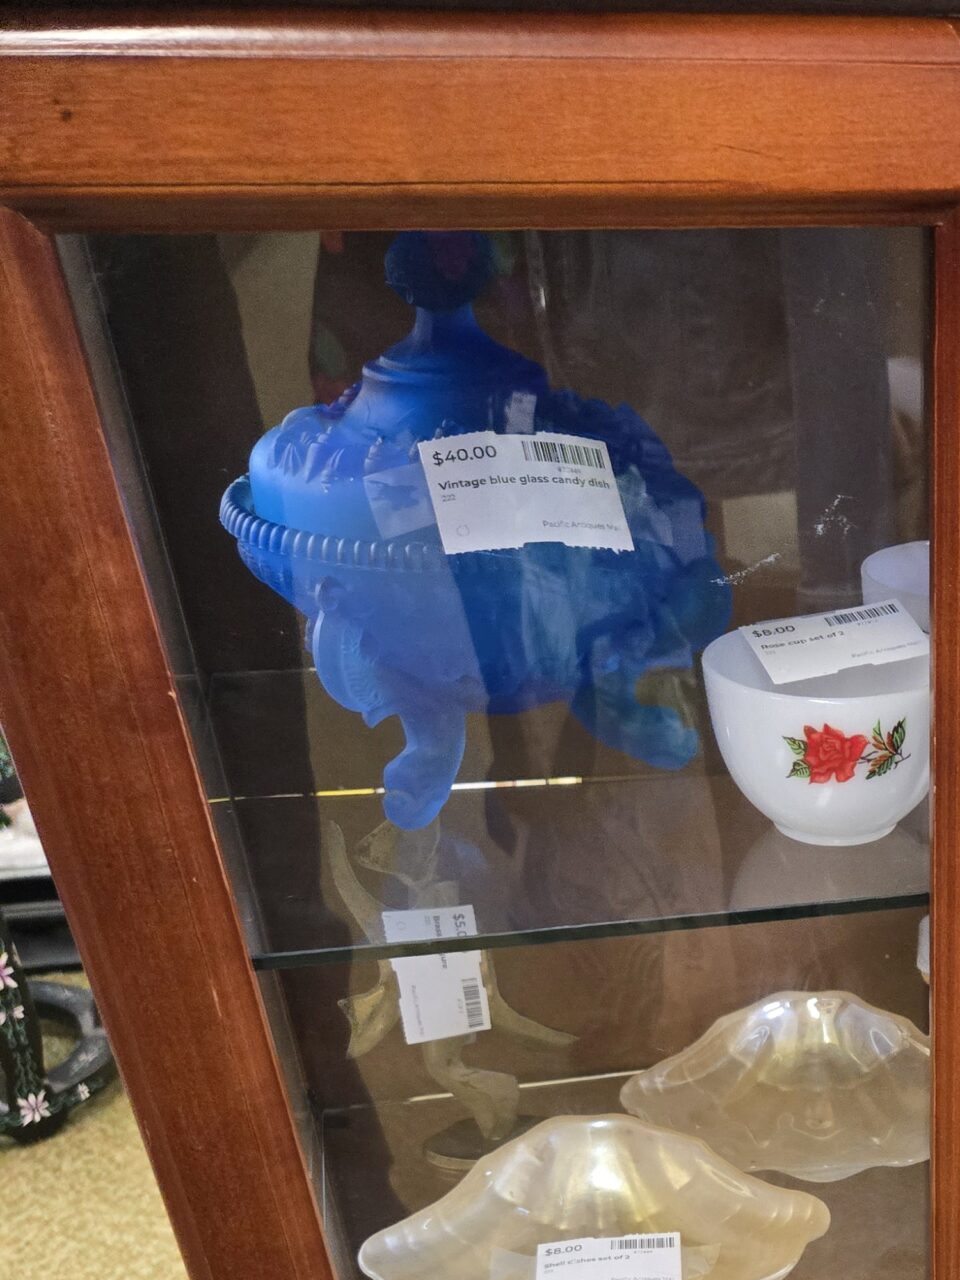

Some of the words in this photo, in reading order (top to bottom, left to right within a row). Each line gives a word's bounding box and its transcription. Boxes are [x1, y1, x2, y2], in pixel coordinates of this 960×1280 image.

[431, 445, 498, 467] $40.00
[438, 477, 487, 491] Vintage
[490, 474, 517, 485] blue
[519, 474, 550, 486] glass
[552, 474, 586, 488] candy
[588, 477, 611, 489] dish
[788, 639, 807, 649] cup
[809, 634, 824, 643] set
[453, 913, 467, 938] $5.0
[544, 1244, 583, 1257] $8.00
